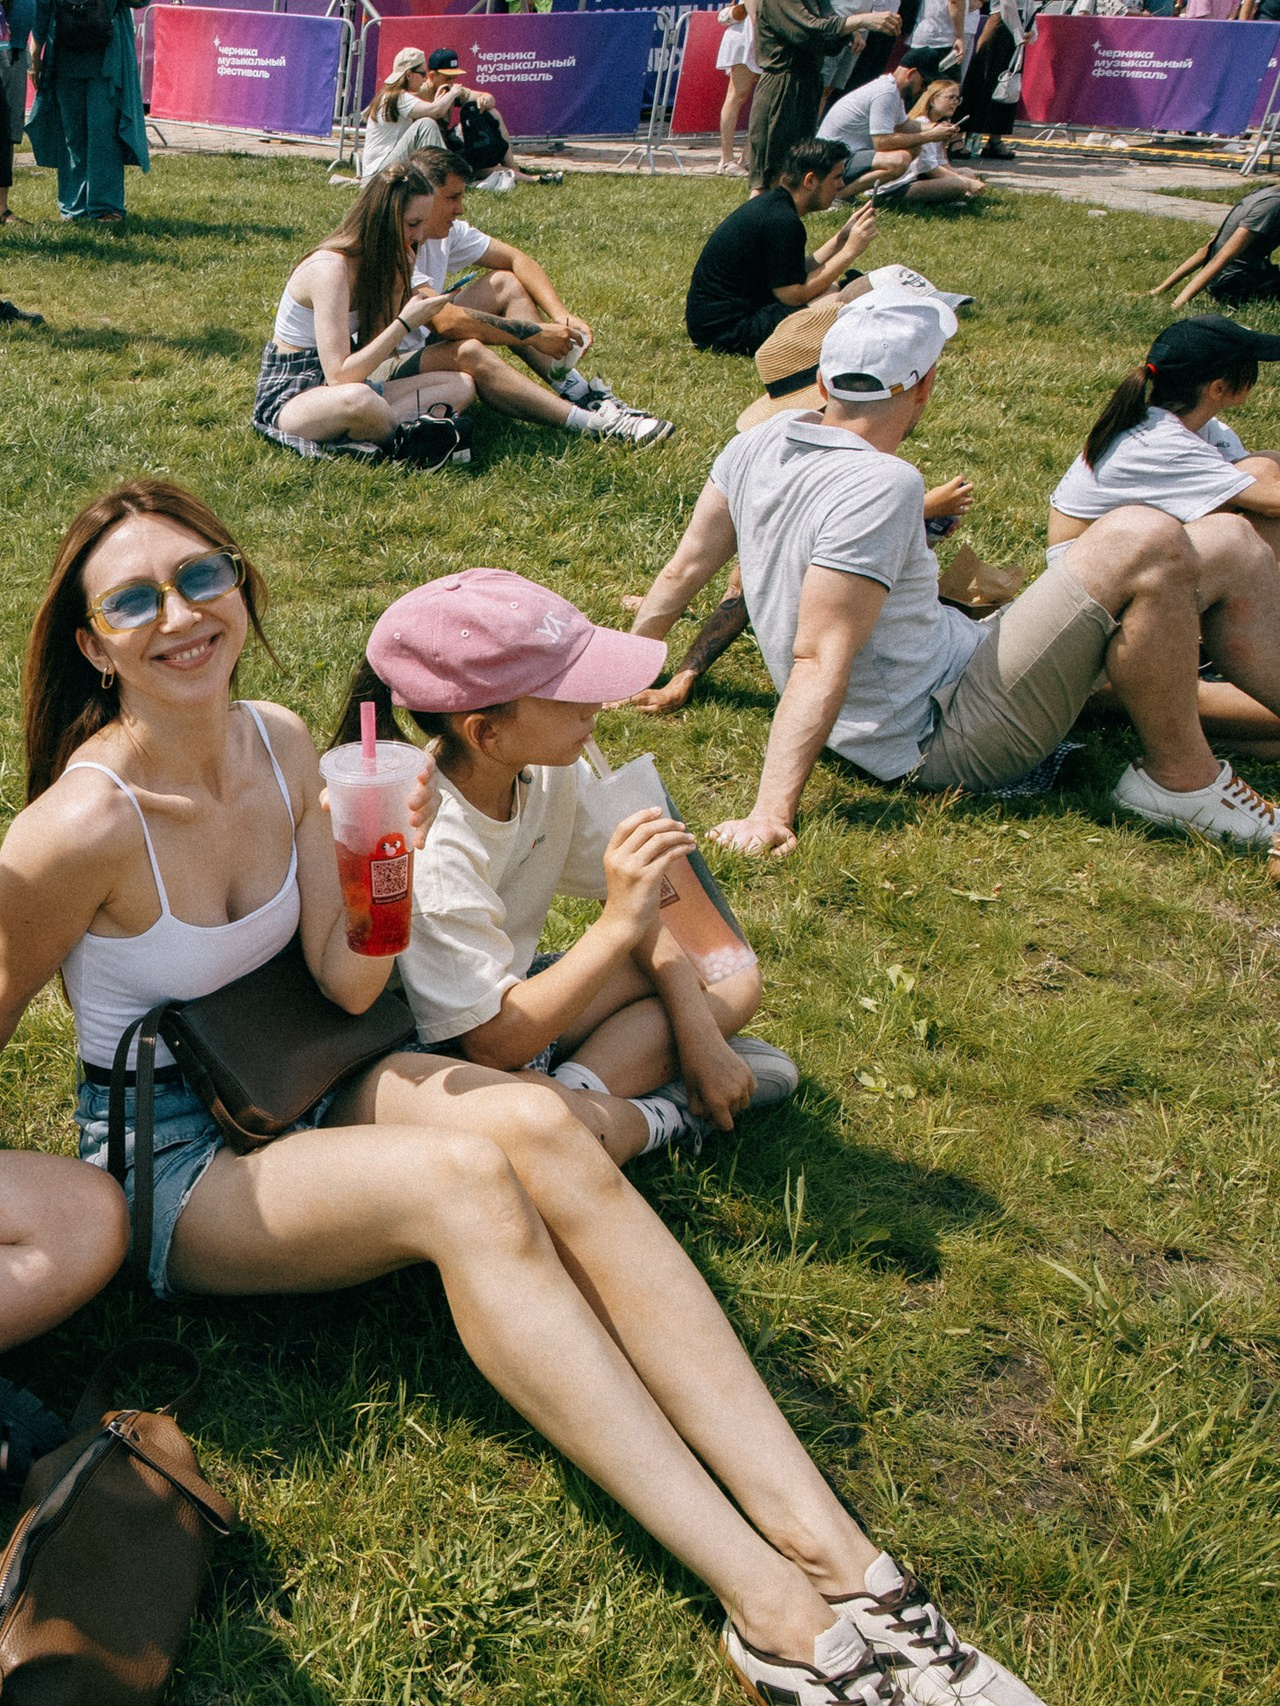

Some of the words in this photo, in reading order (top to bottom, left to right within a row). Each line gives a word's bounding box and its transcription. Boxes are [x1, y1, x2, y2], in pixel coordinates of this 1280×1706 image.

[218, 46, 258, 56] черника
[478, 51, 536, 62] черника
[1097, 49, 1154, 60] черника
[217, 56, 286, 66] музыкальный
[476, 56, 576, 73] музыкальный
[1094, 58, 1193, 69] музыкальный
[217, 65, 270, 78] фестиваль
[1092, 68, 1167, 80] фестиваль
[476, 73, 553, 84] фестиваль
